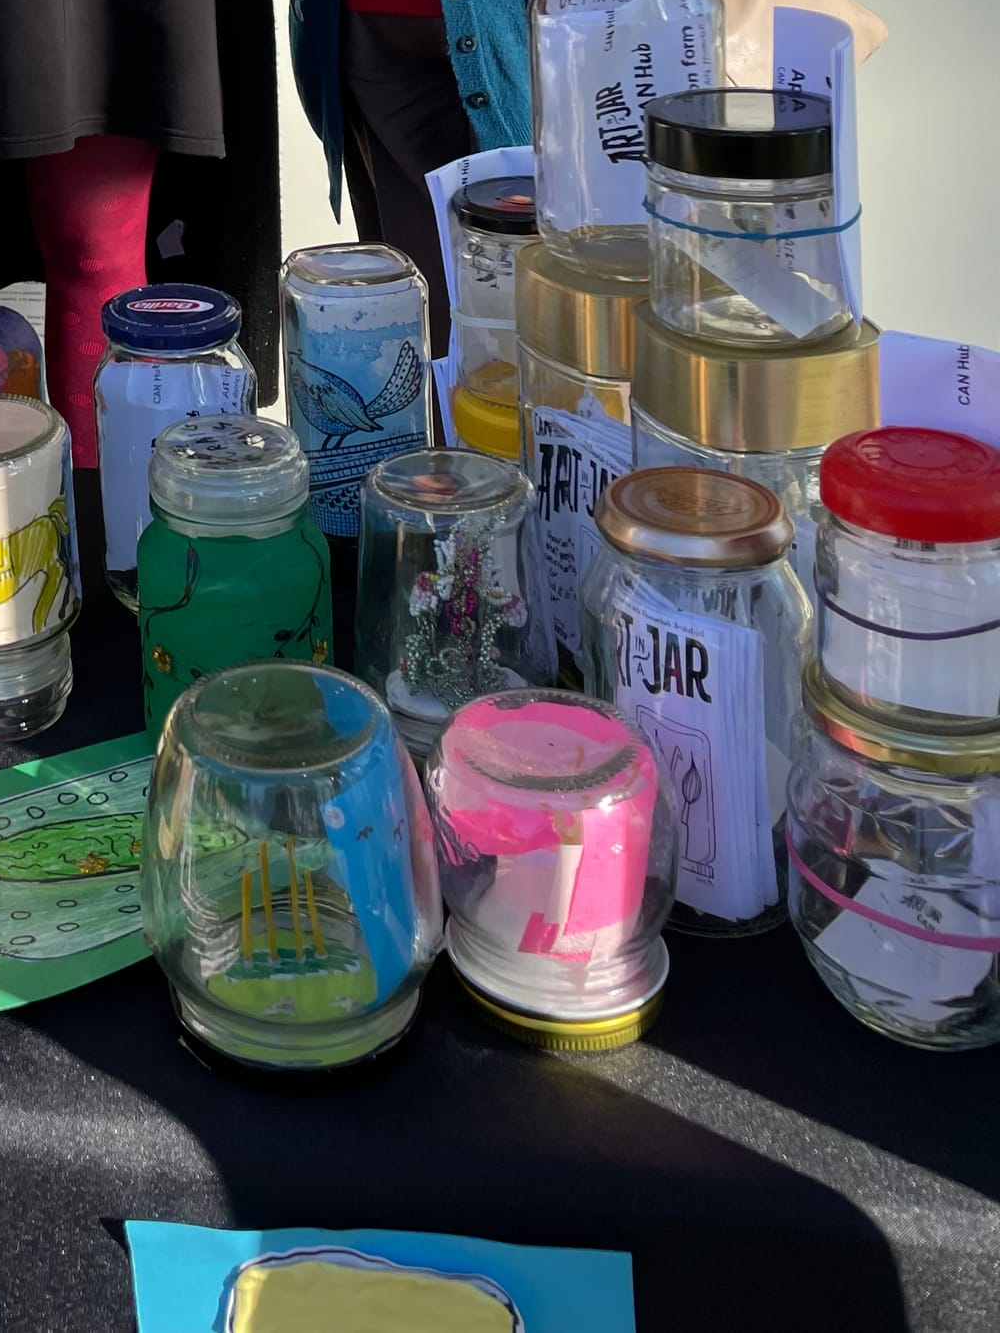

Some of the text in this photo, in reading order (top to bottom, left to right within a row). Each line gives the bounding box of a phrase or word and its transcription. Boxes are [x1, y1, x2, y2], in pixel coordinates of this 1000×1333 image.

[632, 43, 654, 78] Hub
[681, 25, 696, 67] form
[595, 82, 632, 120] JAR
[599, 124, 649, 167] ART
[336, 181, 389, 195] Pat Jarrett
[336, 195, 380, 210] Barooga
[134, 300, 193, 310] Barilla
[957, 345, 970, 405] CAN Hub
[153, 383, 162, 404] CAN
[537, 443, 582, 522] ART
[635, 635, 645, 653] IN
[637, 662, 644, 676] A
[642, 623, 712, 704] JAR
